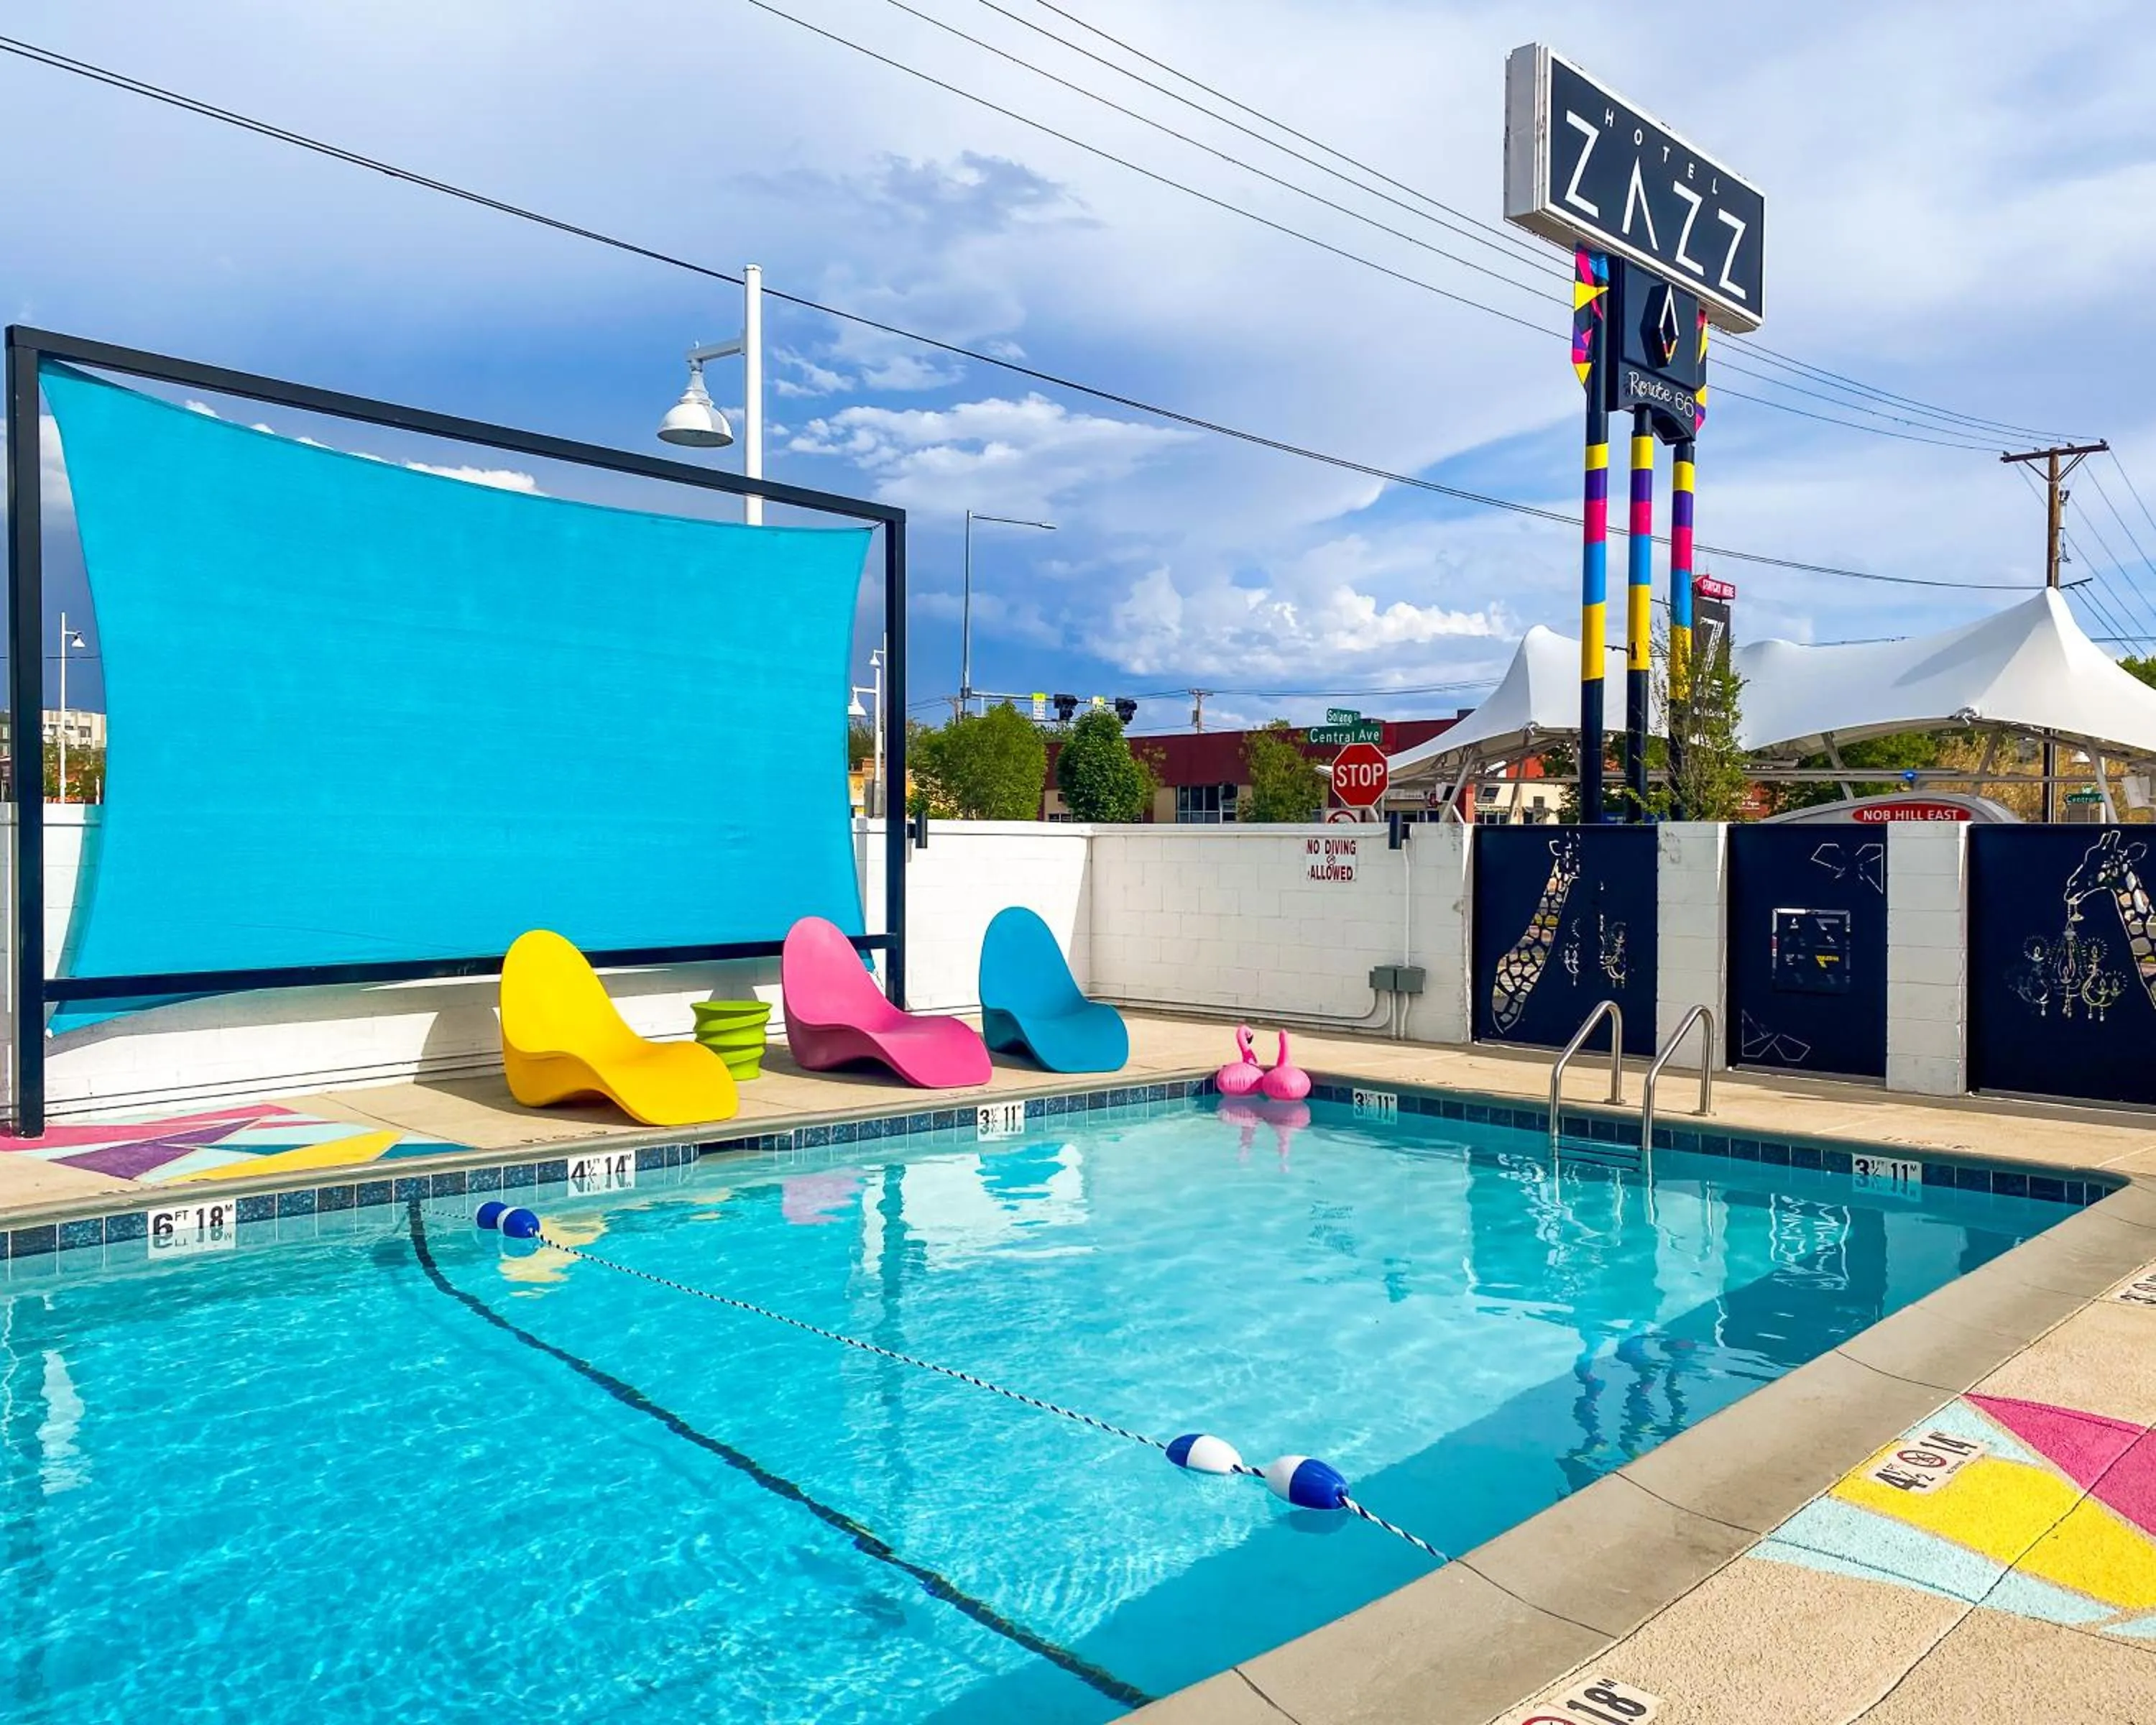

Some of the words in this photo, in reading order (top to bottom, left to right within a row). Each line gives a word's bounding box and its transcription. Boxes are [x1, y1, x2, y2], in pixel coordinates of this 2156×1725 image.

[1605, 108, 1718, 195] HOTEL
[1565, 109, 1746, 300] ZAZZ
[1628, 371, 1673, 402] Route
[1675, 393, 1695, 418] 66
[1328, 709, 1353, 723] Solano
[1310, 728, 1355, 743] Central
[1358, 729, 1379, 741] Ave
[1336, 763, 1384, 788] STOP
[1863, 810, 1891, 821] NOB
[1894, 810, 1924, 821] HILL
[1927, 809, 1958, 821] EAST
[1307, 839, 1320, 855] NO
[1325, 840, 1356, 855] DIVING
[1310, 865, 1353, 880] ALLOWED
